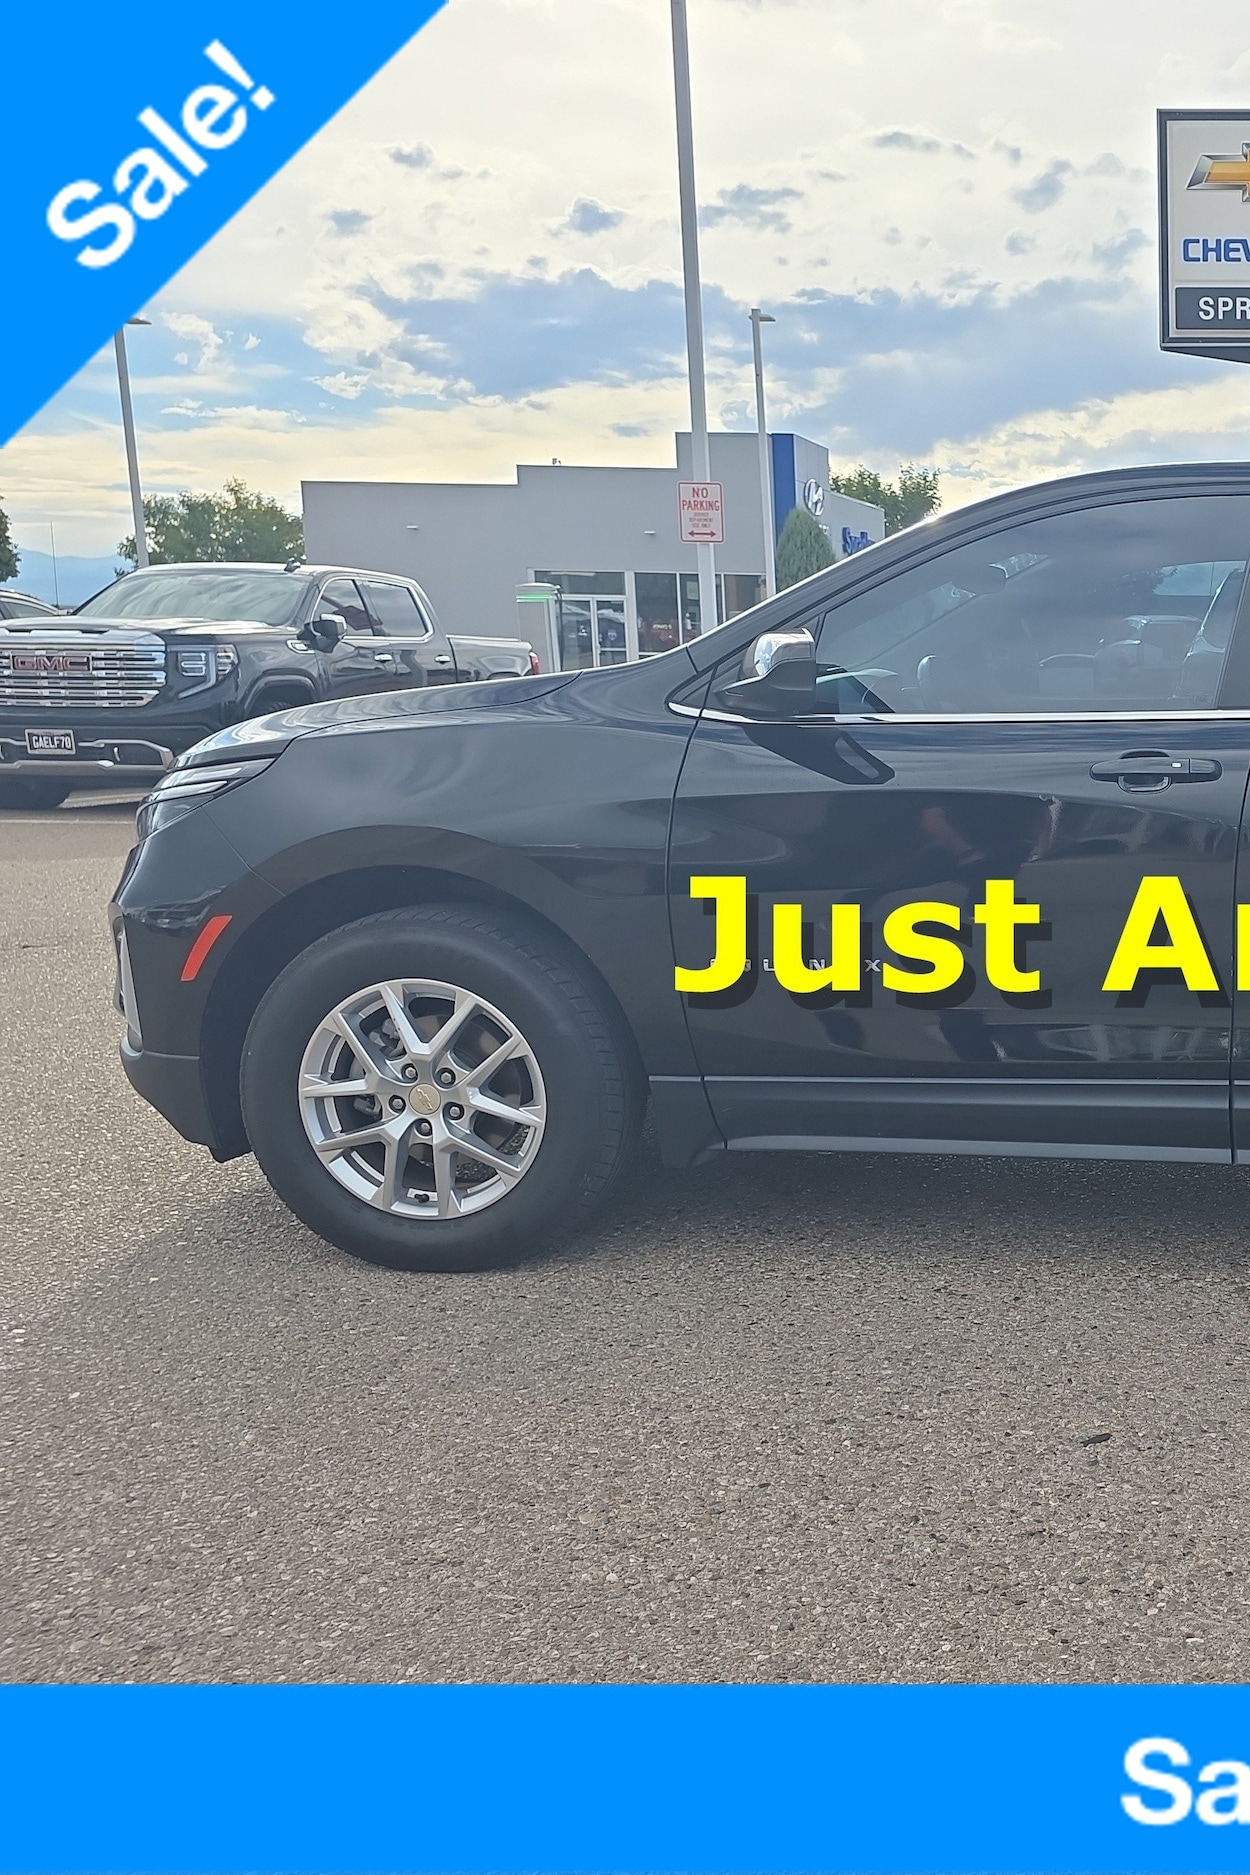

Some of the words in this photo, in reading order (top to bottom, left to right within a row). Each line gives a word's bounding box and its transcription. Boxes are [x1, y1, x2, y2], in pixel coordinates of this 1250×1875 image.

[692, 487, 709, 499] NO
[682, 499, 720, 512] PARKING
[14, 656, 88, 671] GMC
